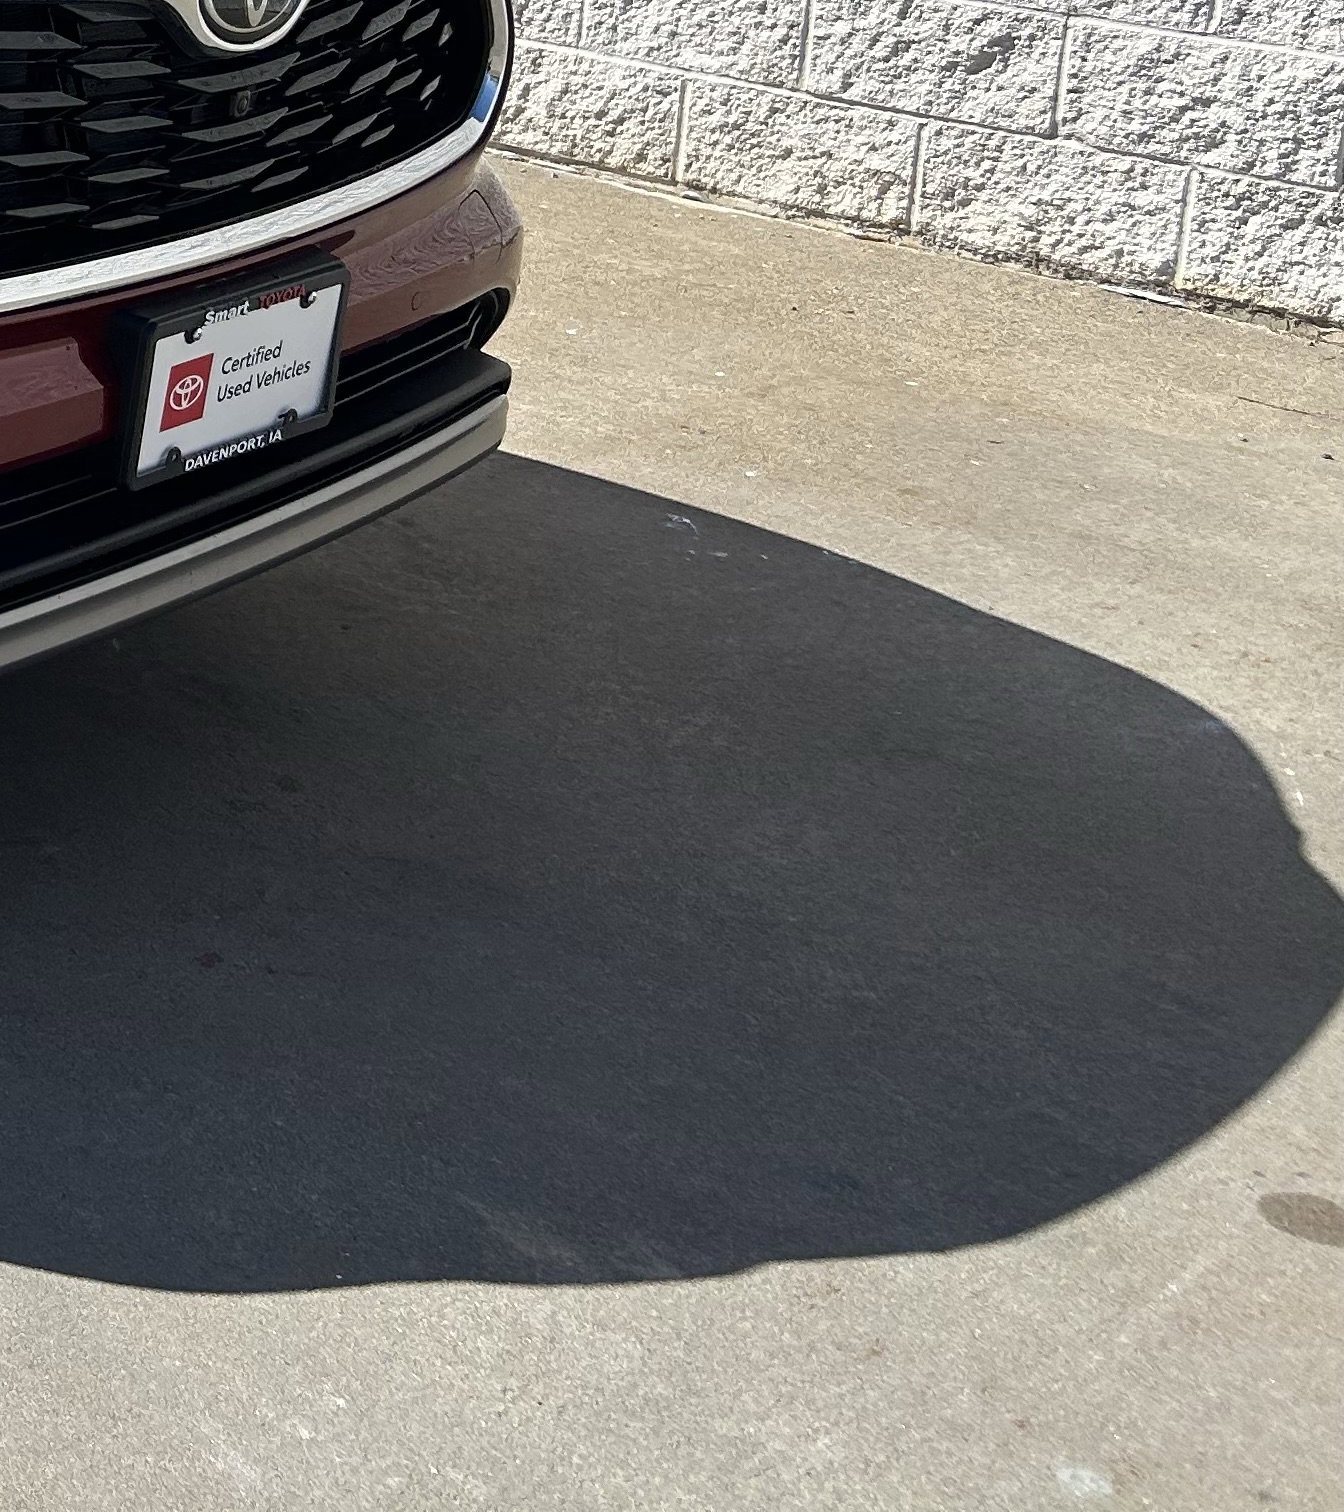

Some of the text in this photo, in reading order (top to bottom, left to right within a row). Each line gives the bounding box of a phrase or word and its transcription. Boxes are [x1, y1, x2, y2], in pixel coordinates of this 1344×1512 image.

[204, 284, 306, 326] Smart TOYOTA
[221, 340, 283, 375] Certified
[217, 360, 311, 402] Used Vehicles
[184, 429, 283, 472] DAVENPORT, IA
